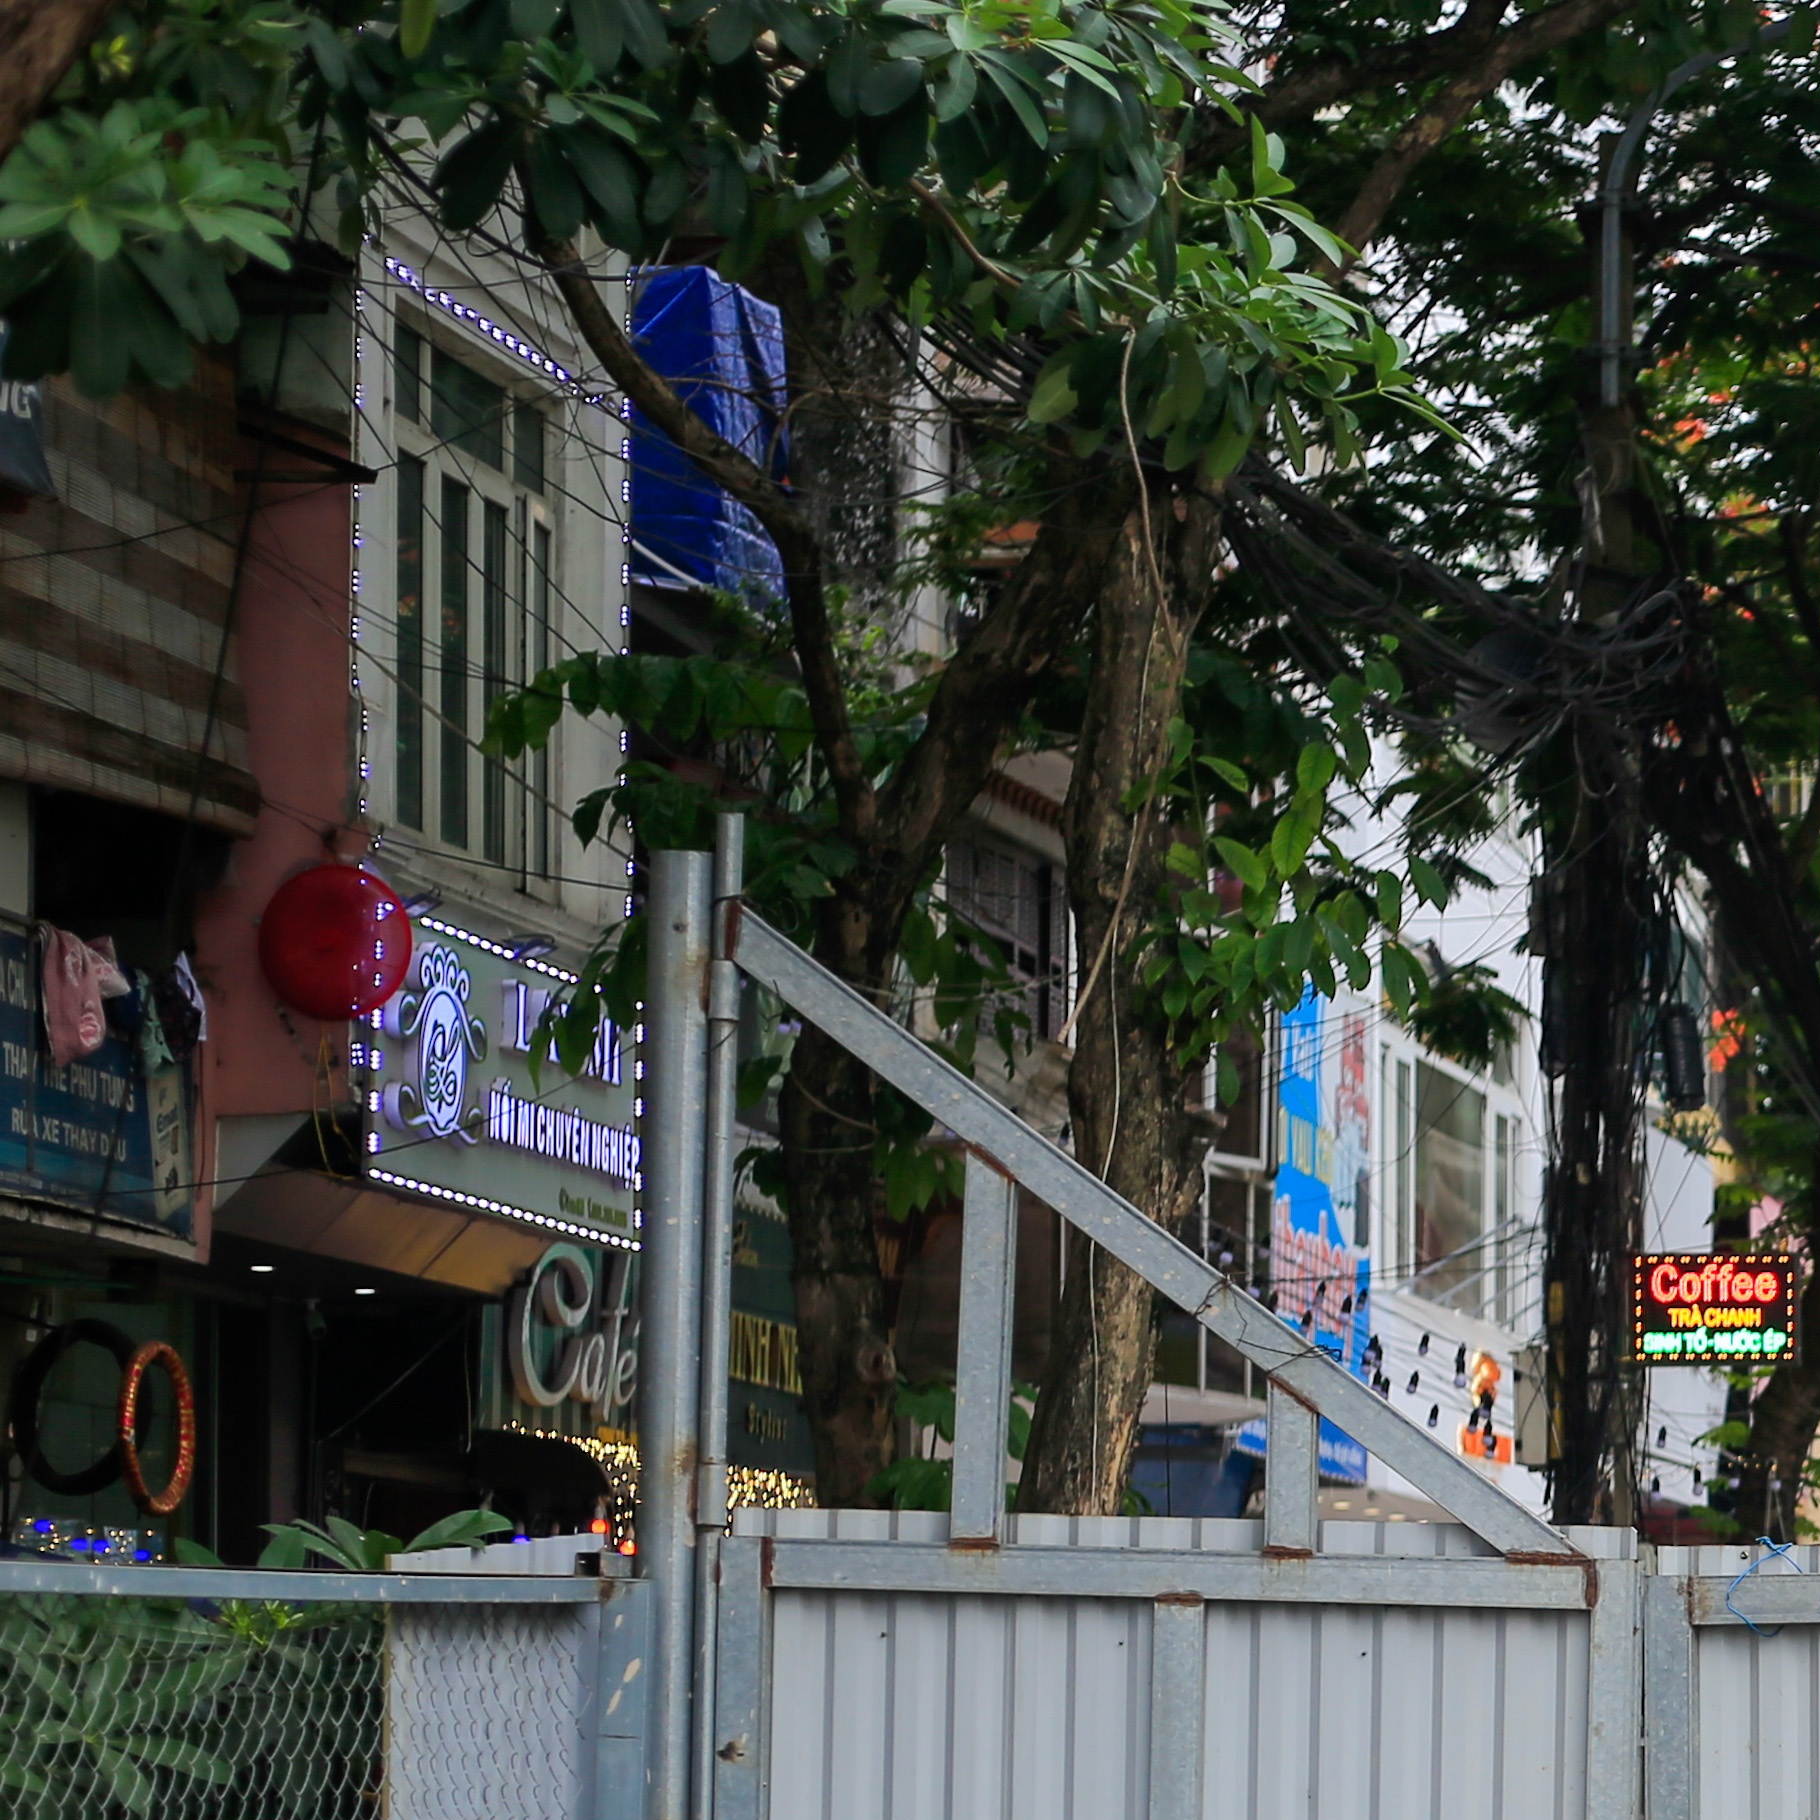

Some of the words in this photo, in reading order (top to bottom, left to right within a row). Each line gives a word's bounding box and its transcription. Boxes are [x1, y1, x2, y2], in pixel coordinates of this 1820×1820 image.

[42, 1116, 59, 1141] XE
[63, 1122, 96, 1154] THAY
[1651, 1263, 1777, 1303] Coffee
[1667, 1304, 1703, 1328] TRÀ
[1704, 1307, 1762, 1328] CHANH
